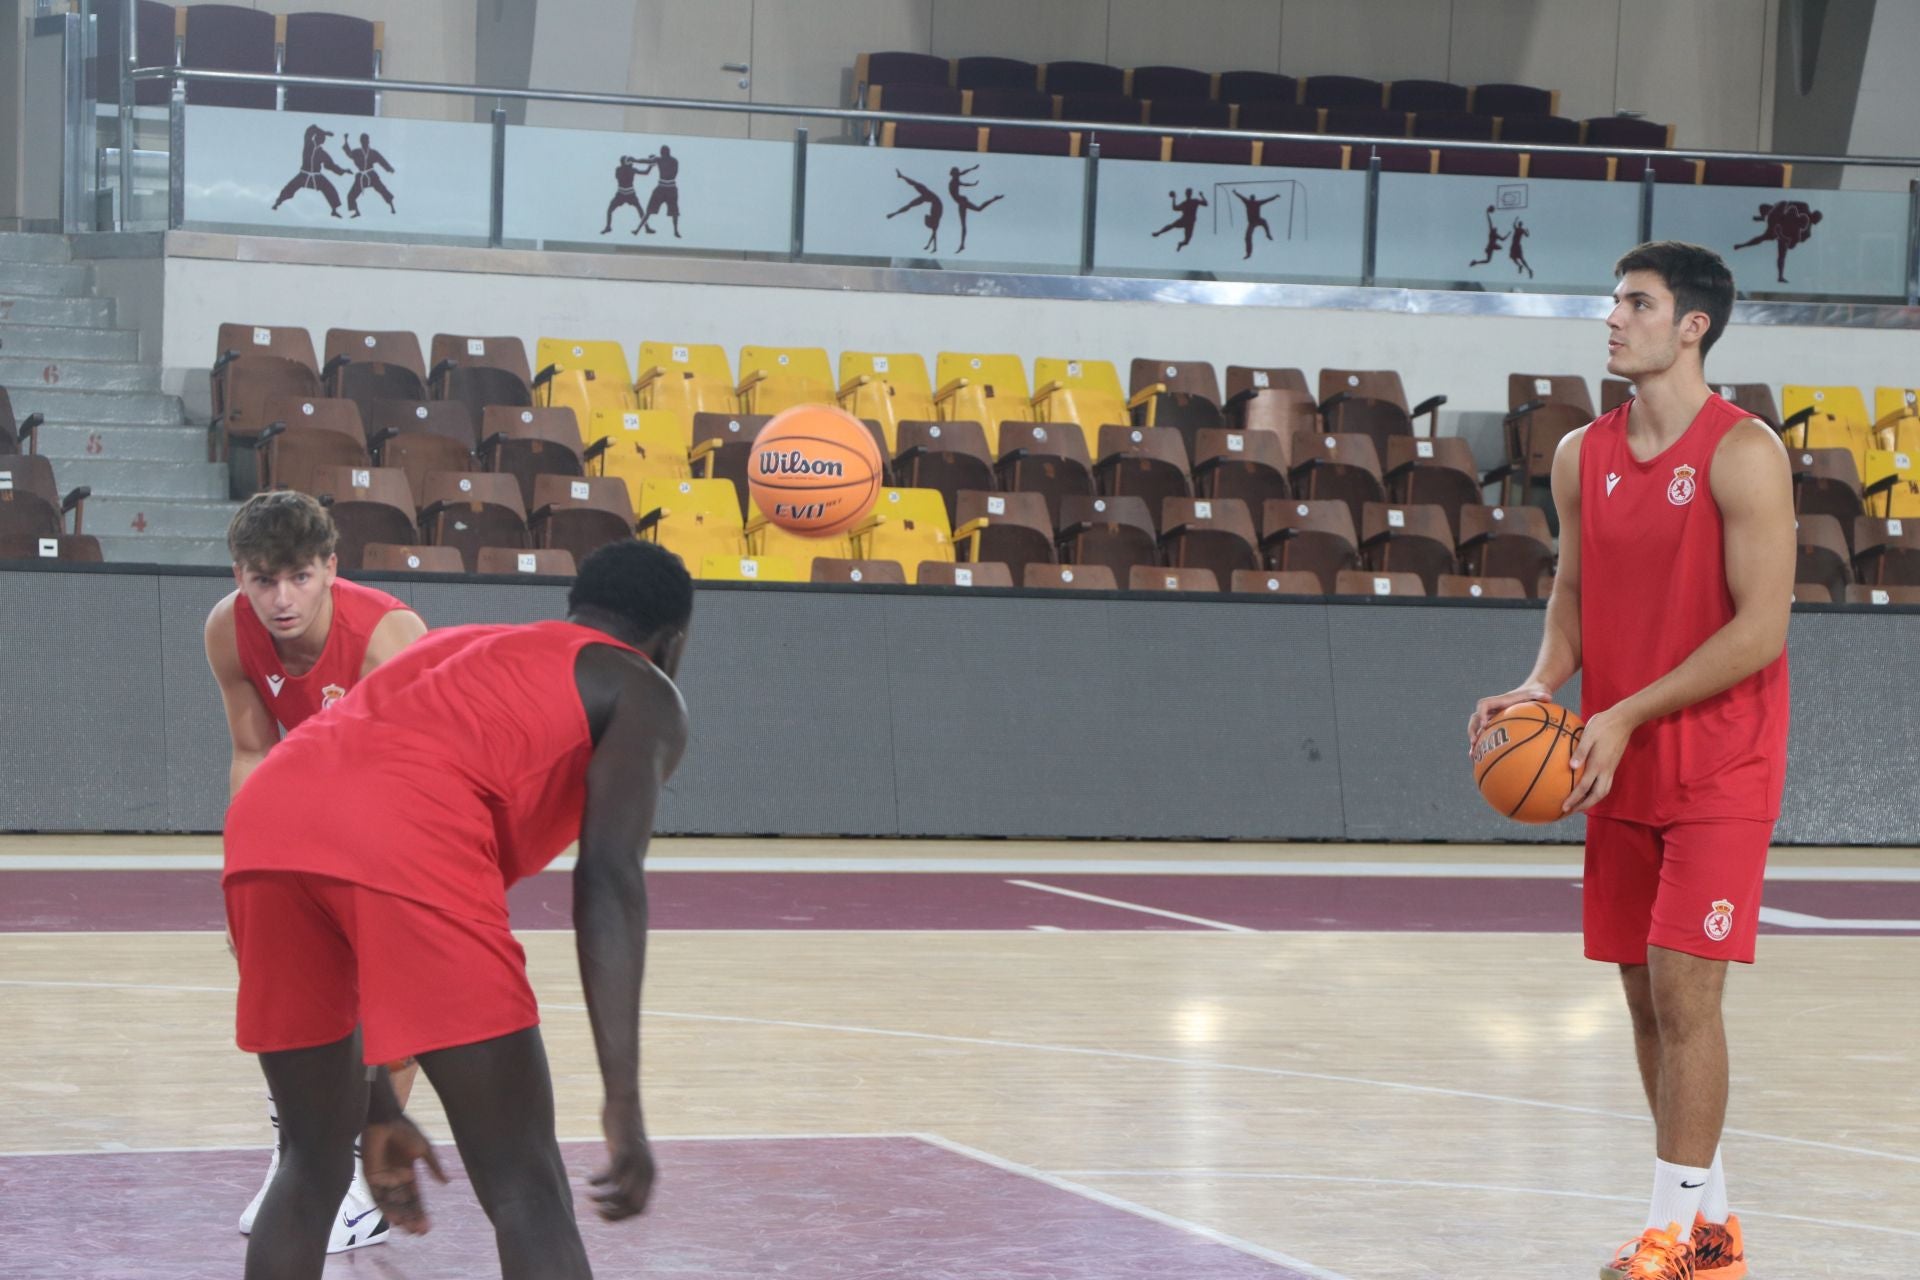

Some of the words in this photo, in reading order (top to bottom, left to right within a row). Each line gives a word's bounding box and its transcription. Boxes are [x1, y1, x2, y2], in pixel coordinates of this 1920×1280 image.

[43, 364, 59, 385] 6
[760, 451, 843, 477] Wilson
[775, 503, 825, 519] EVO
[131, 511, 147, 533] 4
